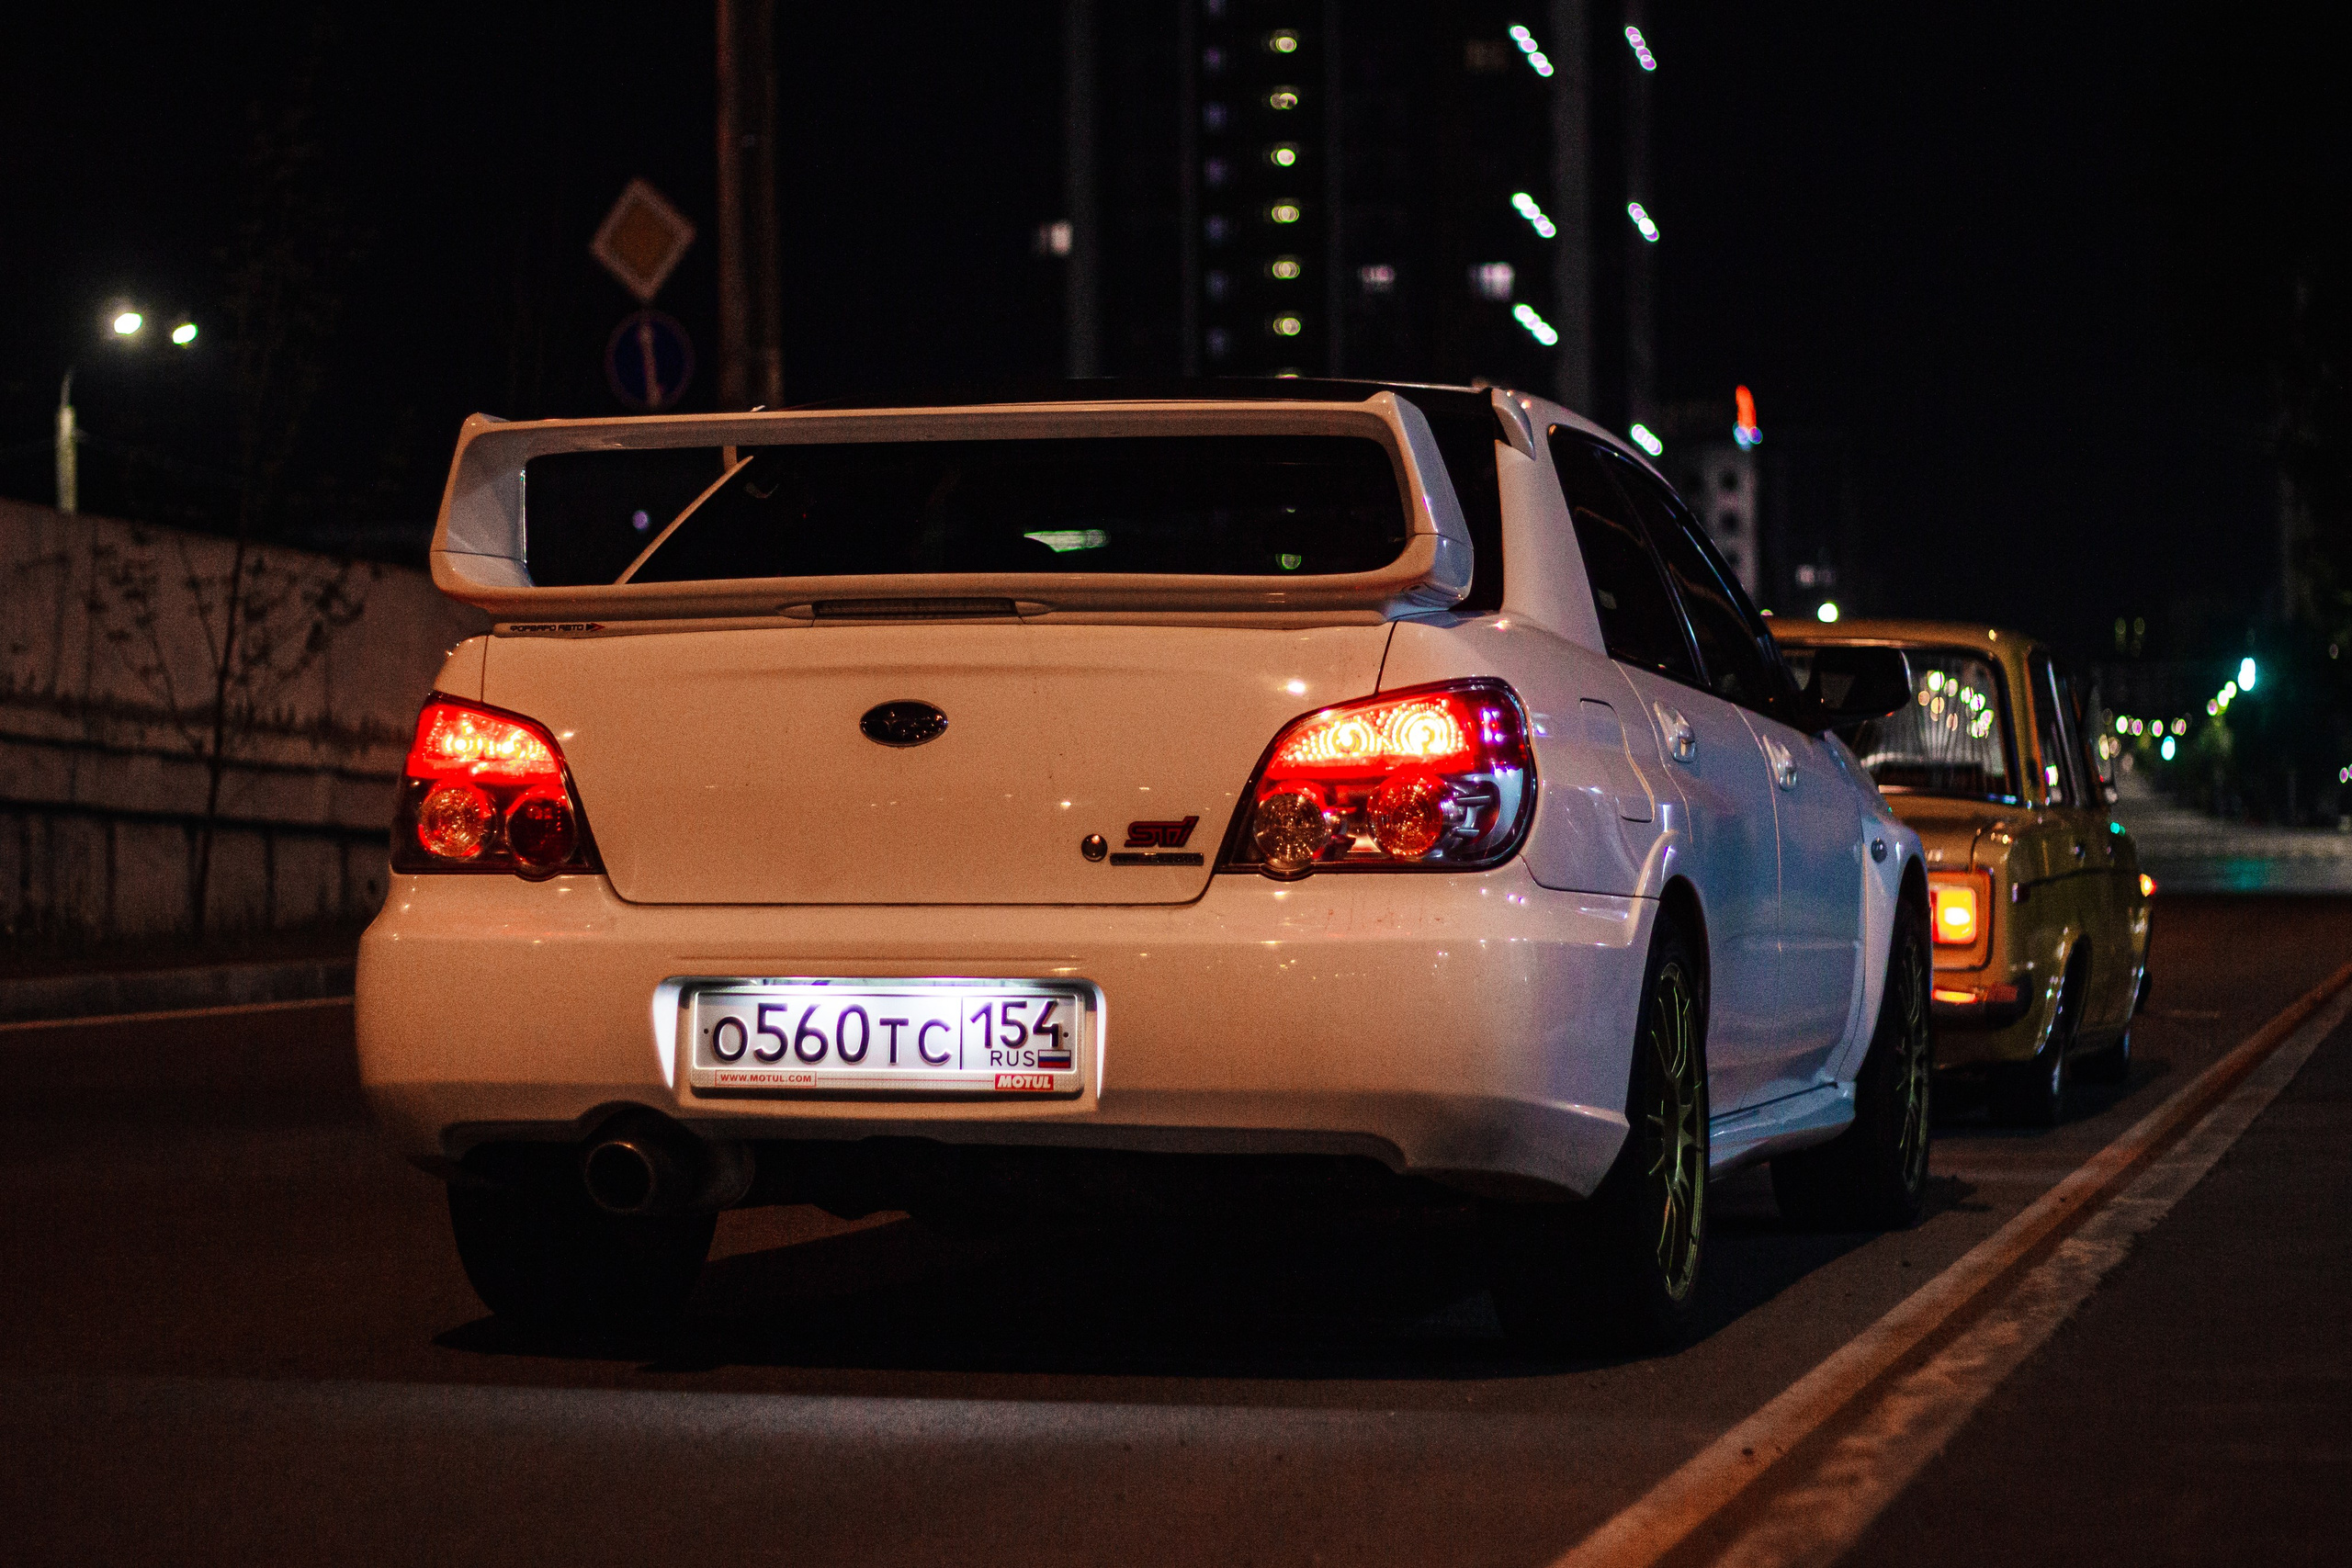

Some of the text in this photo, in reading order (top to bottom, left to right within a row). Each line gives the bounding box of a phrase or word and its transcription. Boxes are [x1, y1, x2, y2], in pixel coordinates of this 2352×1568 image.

[969, 1000, 1059, 1048] 154
[990, 1050, 1035, 1066] RUS
[720, 1074, 1051, 1089] WWW.MOTUL.COM MOTUL
